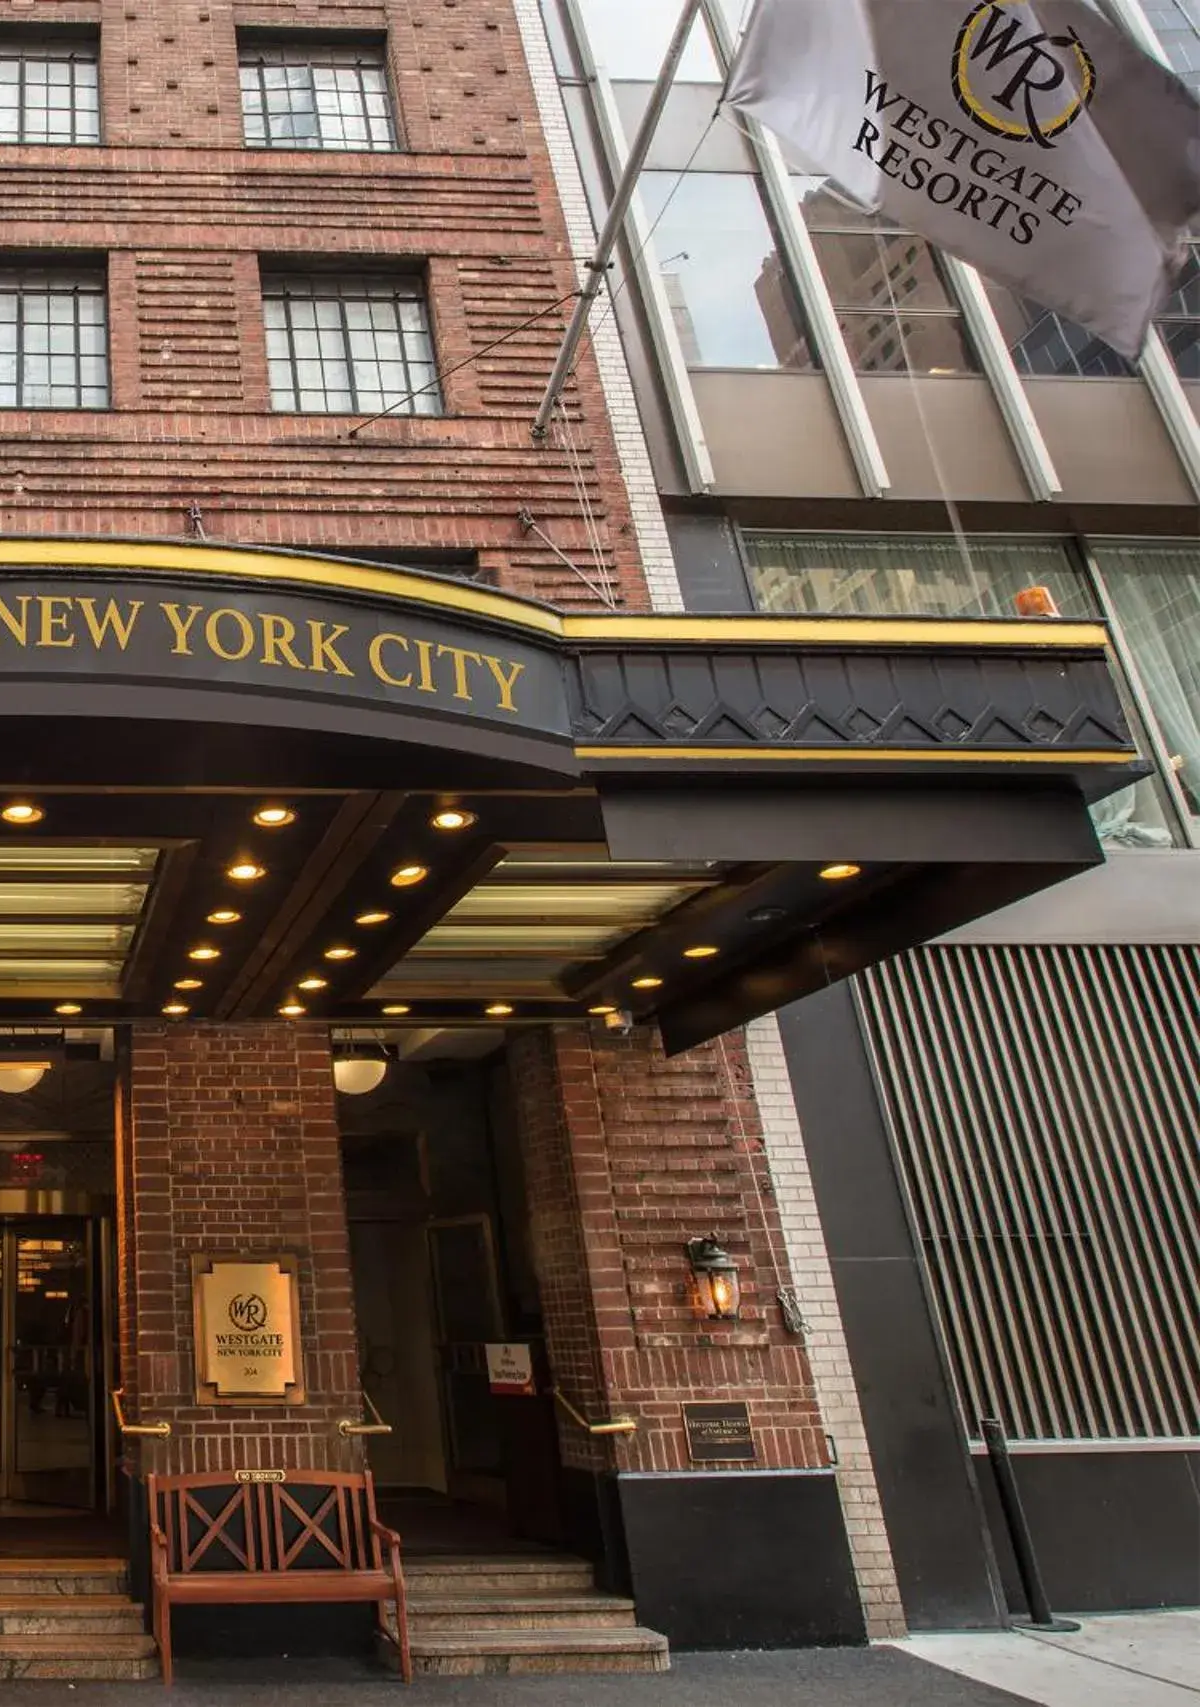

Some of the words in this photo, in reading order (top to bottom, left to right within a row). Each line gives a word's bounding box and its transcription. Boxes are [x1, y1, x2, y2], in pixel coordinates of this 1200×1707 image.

[852, 116, 1041, 245] RESORTS
[864, 69, 1083, 227] WESTGATE
[159, 602, 355, 678] YORK
[368, 632, 525, 712] CITY
[216, 1333, 284, 1345] WESTGATE
[217, 1348, 236, 1357] NEW
[238, 1348, 261, 1357] YORK
[263, 1348, 283, 1357] CITY
